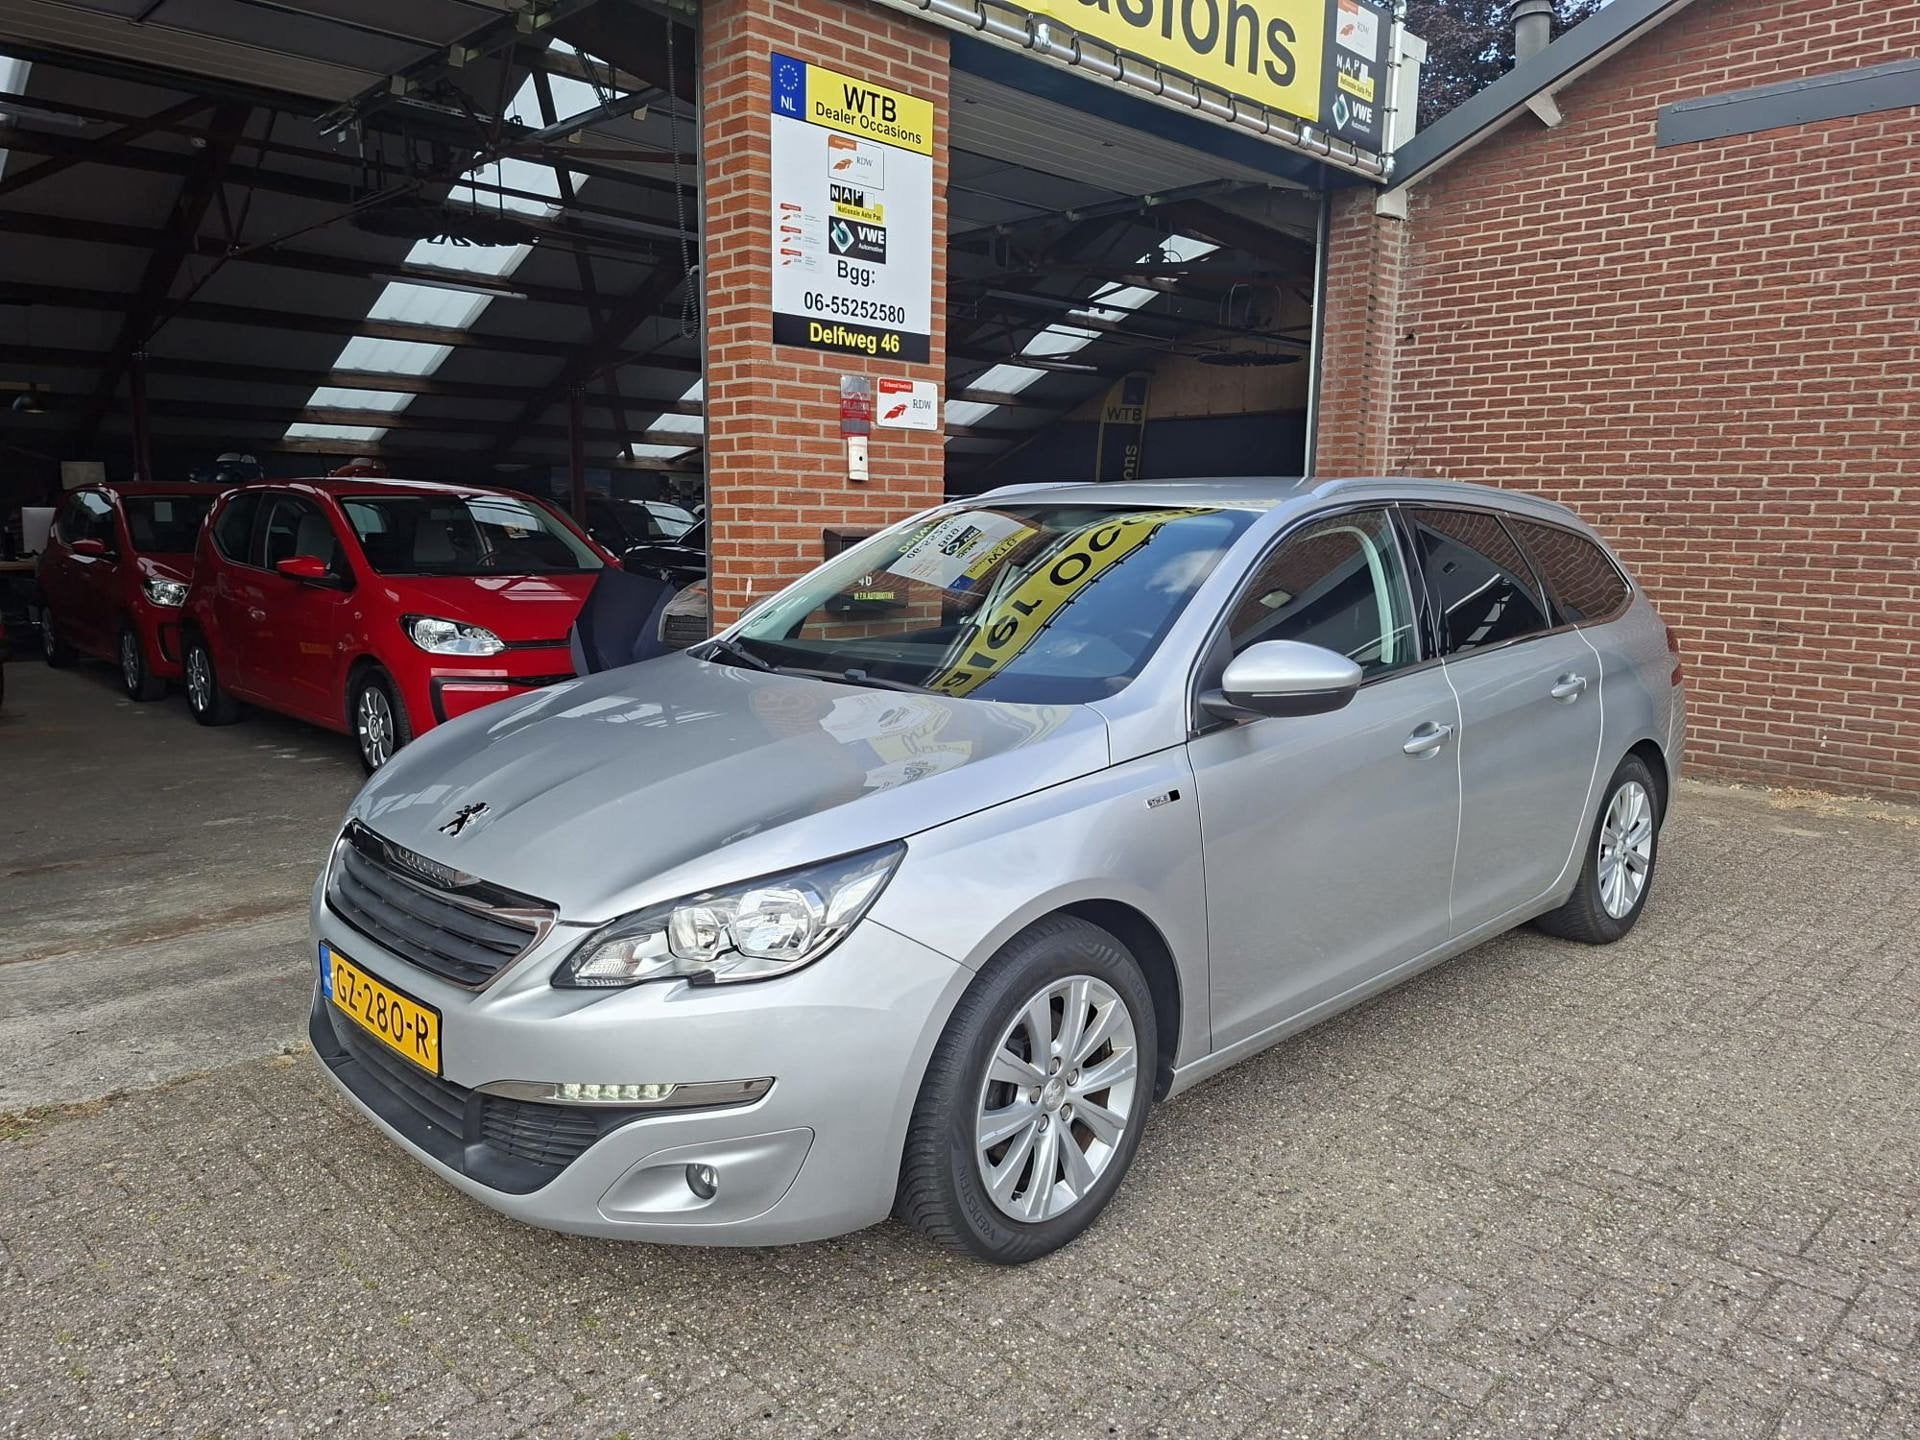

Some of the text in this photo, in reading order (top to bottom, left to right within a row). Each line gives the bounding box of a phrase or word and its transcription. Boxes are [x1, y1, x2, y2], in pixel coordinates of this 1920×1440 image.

[780, 95, 796, 112] NL
[843, 83, 897, 123] WTB
[1352, 100, 1372, 124] VWE
[816, 101, 857, 127] Dealer
[860, 114, 922, 145] Occasions
[856, 155, 874, 168] RDW
[831, 186, 862, 201] NAP
[857, 225, 885, 245] VWE
[837, 260, 876, 287] Bgg:
[804, 291, 906, 325] 06-55252580
[810, 322, 900, 354] Delfweg 46
[912, 398, 932, 410] RDW
[1106, 407, 1143, 421] WTB
[336, 963, 430, 1061] GZ-280-R
